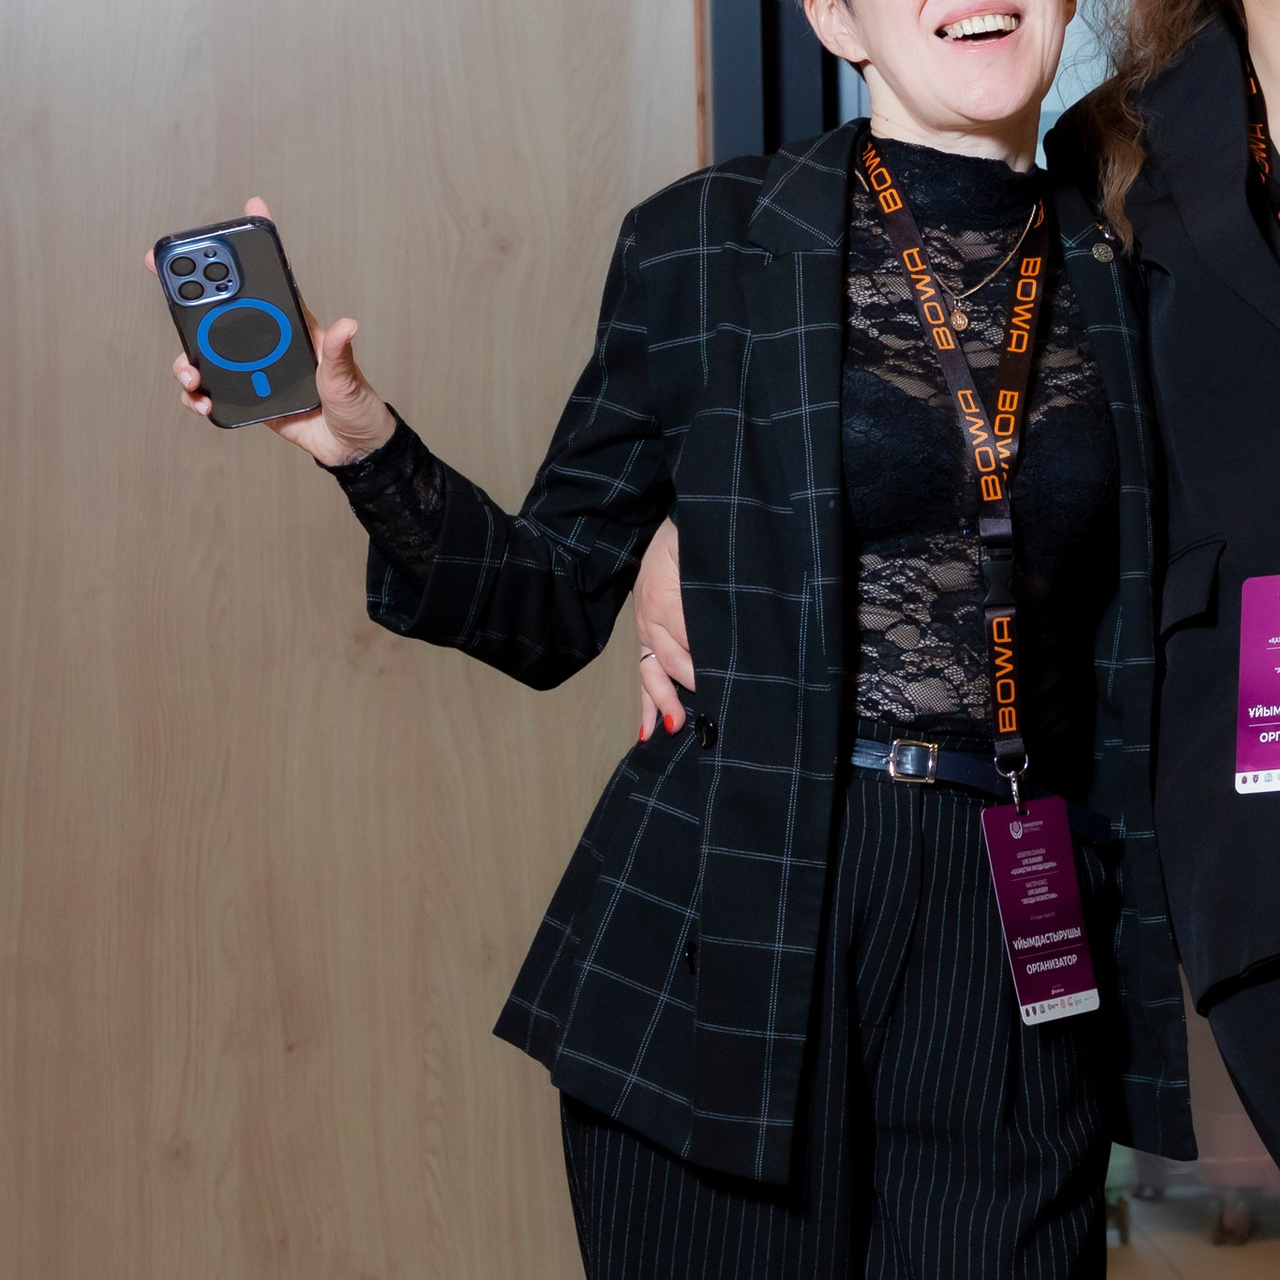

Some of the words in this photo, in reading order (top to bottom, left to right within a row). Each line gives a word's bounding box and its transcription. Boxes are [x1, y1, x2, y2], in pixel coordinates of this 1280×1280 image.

[902, 247, 956, 351] BOWA
[1006, 256, 1042, 354] BOWA
[957, 389, 1003, 503] BOWA
[994, 389, 1020, 484] BOW
[992, 616, 1018, 733] BOWA
[1026, 953, 1078, 975] ОРГАНИЗАТОР
